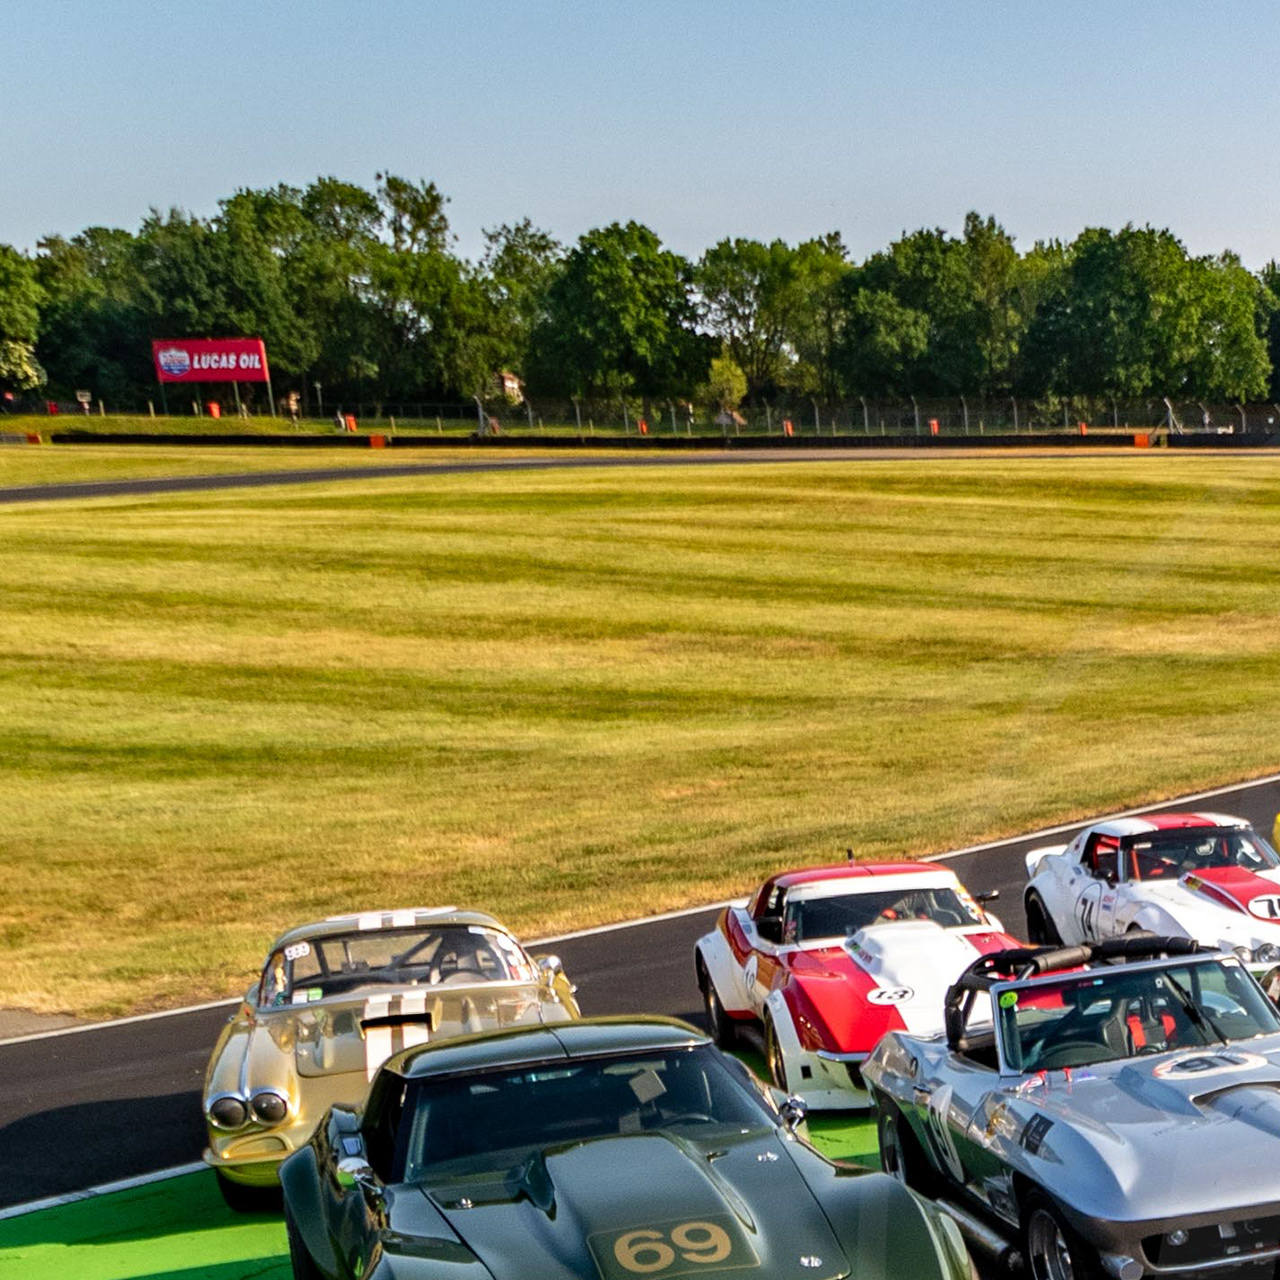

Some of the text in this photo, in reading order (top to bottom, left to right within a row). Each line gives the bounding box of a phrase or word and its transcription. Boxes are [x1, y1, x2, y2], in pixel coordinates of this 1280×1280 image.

[192, 352, 236, 370] LUCAS
[238, 352, 262, 370] OIL
[1081, 898, 1097, 942] 74
[874, 987, 908, 1001] 13
[1175, 1055, 1241, 1074] 91
[613, 1220, 733, 1274] 69
